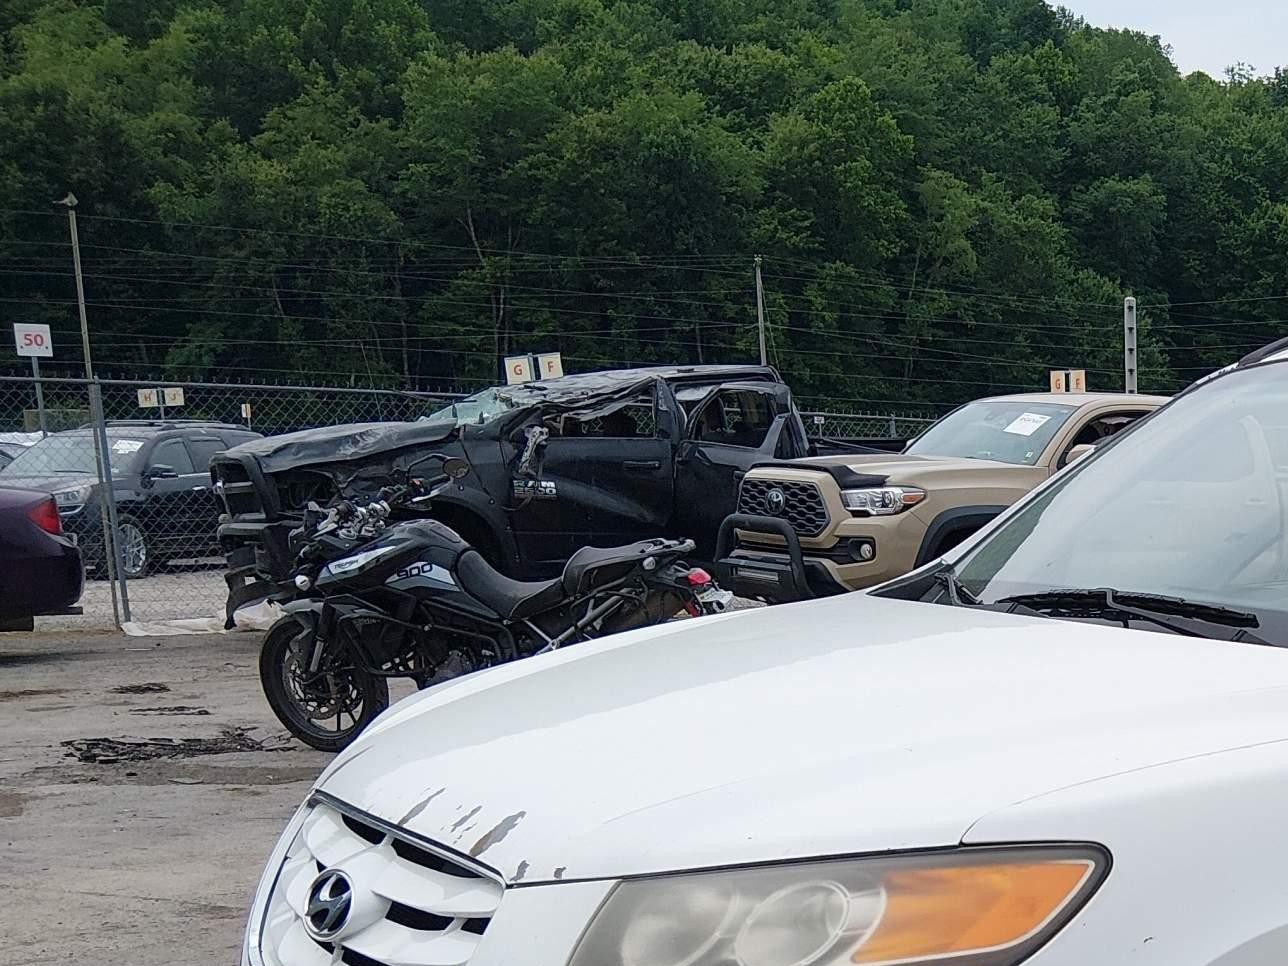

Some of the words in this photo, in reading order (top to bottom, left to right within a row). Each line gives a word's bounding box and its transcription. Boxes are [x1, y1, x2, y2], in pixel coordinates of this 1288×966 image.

[24, 333, 44, 347] 50
[513, 364, 523, 376] G
[547, 361, 555, 373] F
[513, 480, 556, 488] RAM
[397, 562, 433, 578] 900
